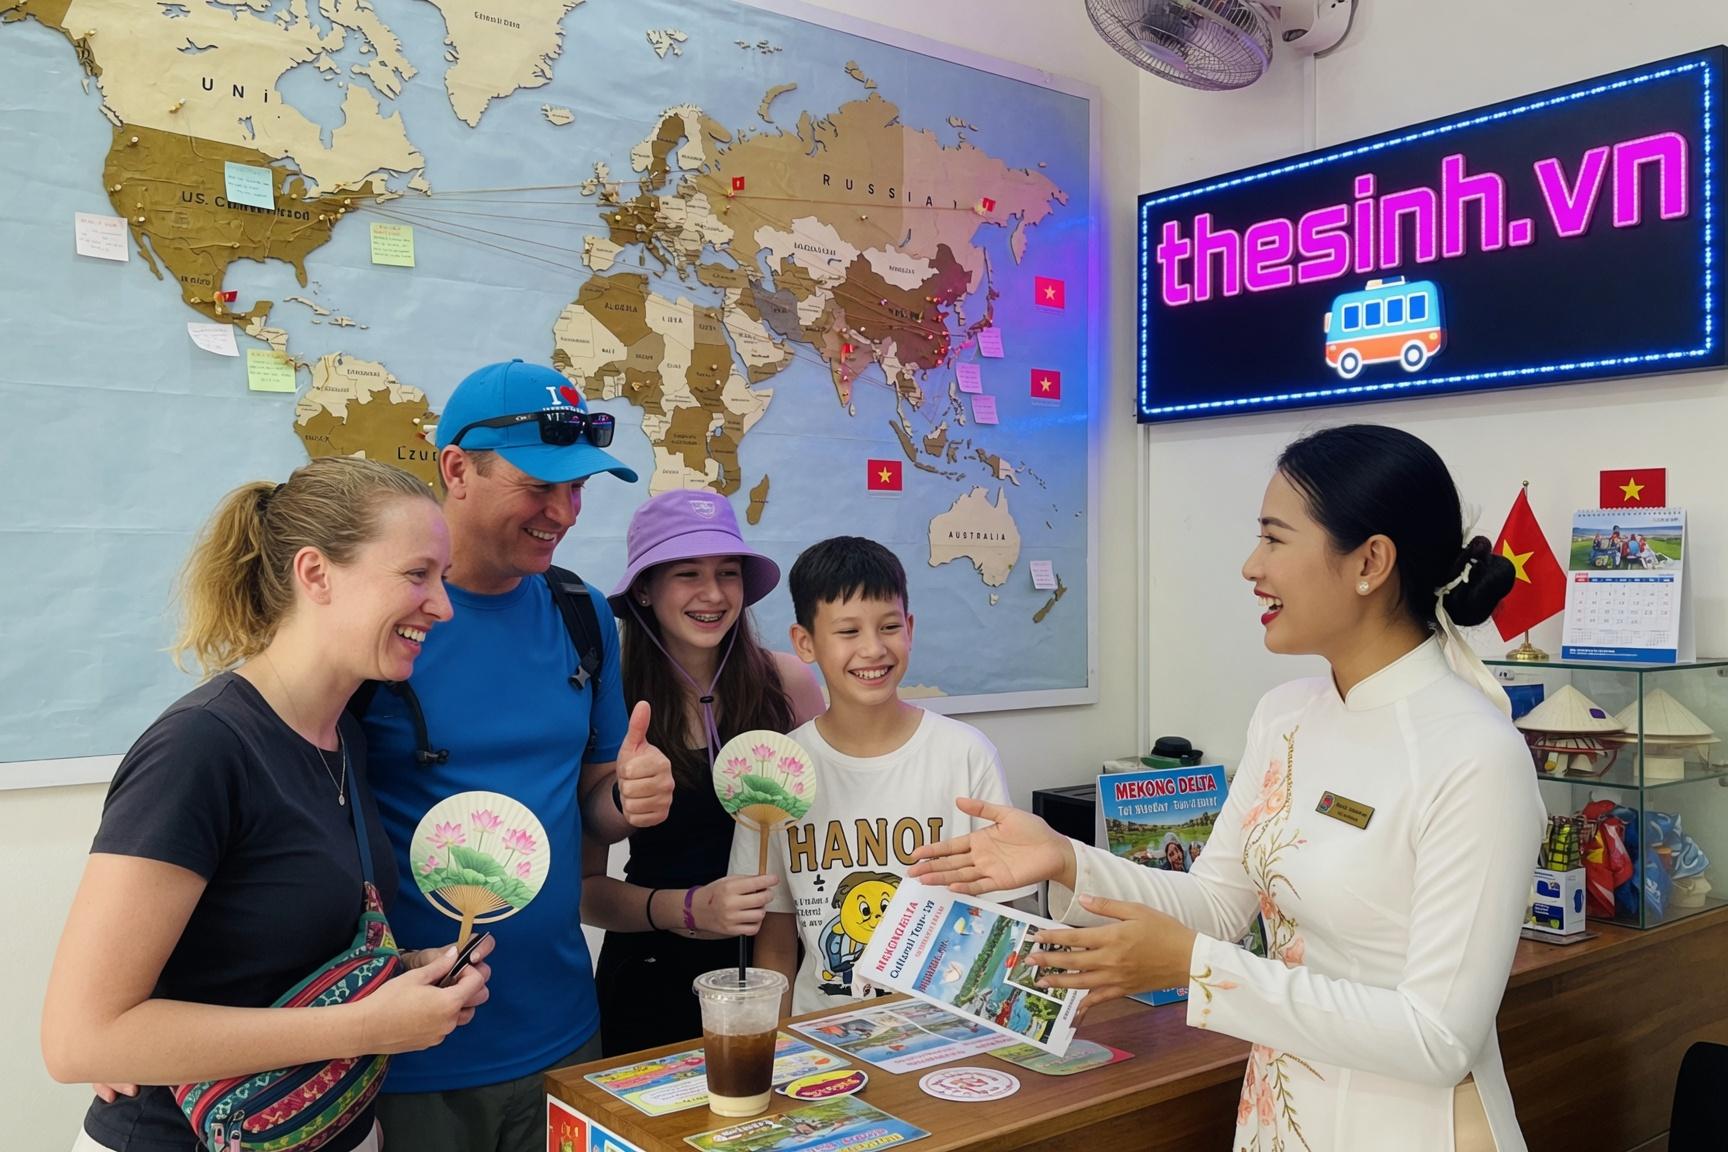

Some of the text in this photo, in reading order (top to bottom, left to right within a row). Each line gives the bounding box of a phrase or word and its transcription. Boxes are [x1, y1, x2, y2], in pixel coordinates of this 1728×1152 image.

[1156, 131, 1689, 307] thesinh.vn
[545, 386, 562, 405] I
[948, 531, 1006, 541] AUSTRALIA
[1114, 773, 1217, 801] MEKONG DELTA
[786, 816, 944, 873] HANOI
